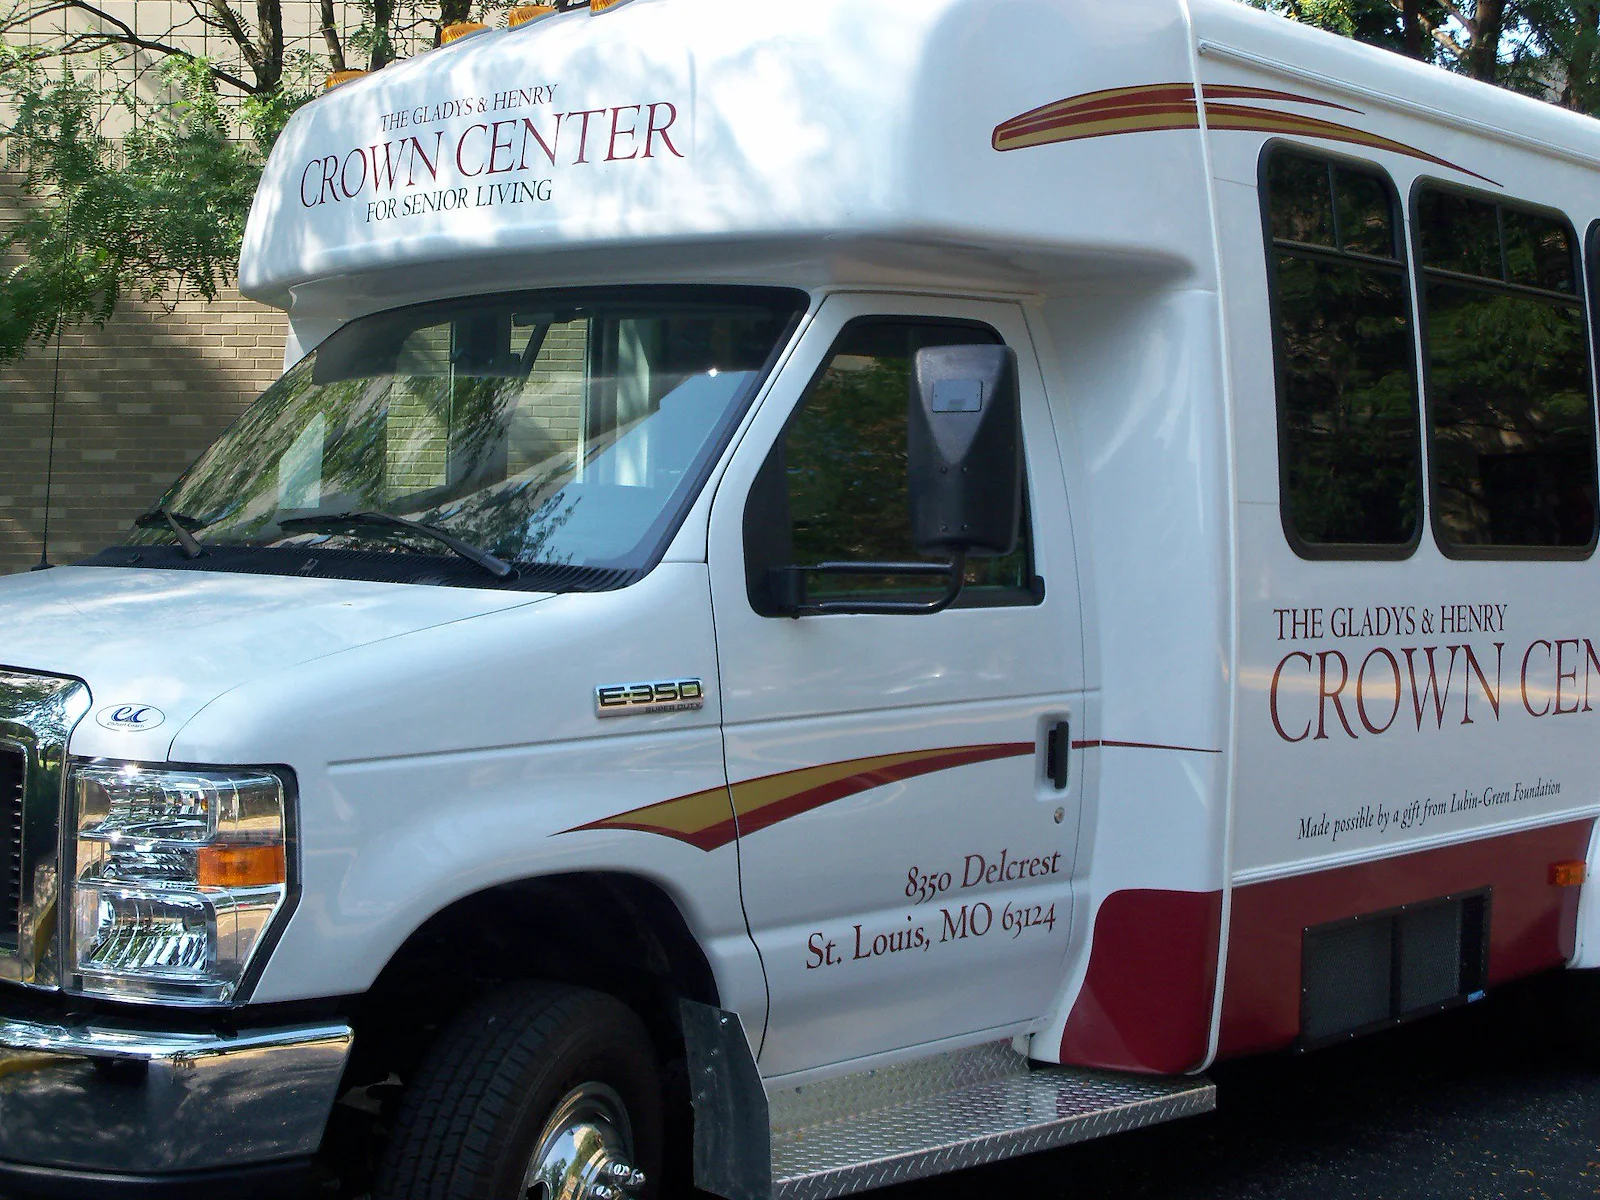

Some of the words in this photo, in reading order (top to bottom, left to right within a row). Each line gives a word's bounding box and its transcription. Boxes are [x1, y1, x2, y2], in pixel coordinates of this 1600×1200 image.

[381, 112, 409, 132] THE
[412, 97, 473, 125] GLADYS
[476, 96, 489, 113] &
[493, 84, 558, 111] HENRY
[300, 131, 444, 208] CROWN
[456, 102, 684, 178] CENTER
[366, 200, 397, 223] FOR
[402, 187, 469, 217] SENIOR
[475, 179, 552, 207] LIVING
[1273, 608, 1324, 640] THE
[1330, 605, 1416, 638] GLADYS
[1421, 604, 1434, 634] &
[1440, 604, 1508, 633] HENRY
[1269, 642, 1505, 743] CROWN
[1298, 812, 1330, 839] Made
[1332, 805, 1374, 842] possible
[1377, 803, 1390, 833] by
[1393, 810, 1399, 823] a
[1400, 800, 1420, 829] gift
[1419, 798, 1447, 826] from
[1450, 786, 1510, 813] Lubin-Green
[1513, 777, 1561, 802] Foundation
[905, 866, 952, 906] 8350
[960, 848, 1062, 889] Delcrest
[806, 932, 842, 970] St.
[852, 914, 931, 960] Louis,
[939, 902, 993, 944] MO
[1002, 901, 1056, 940] 63124
